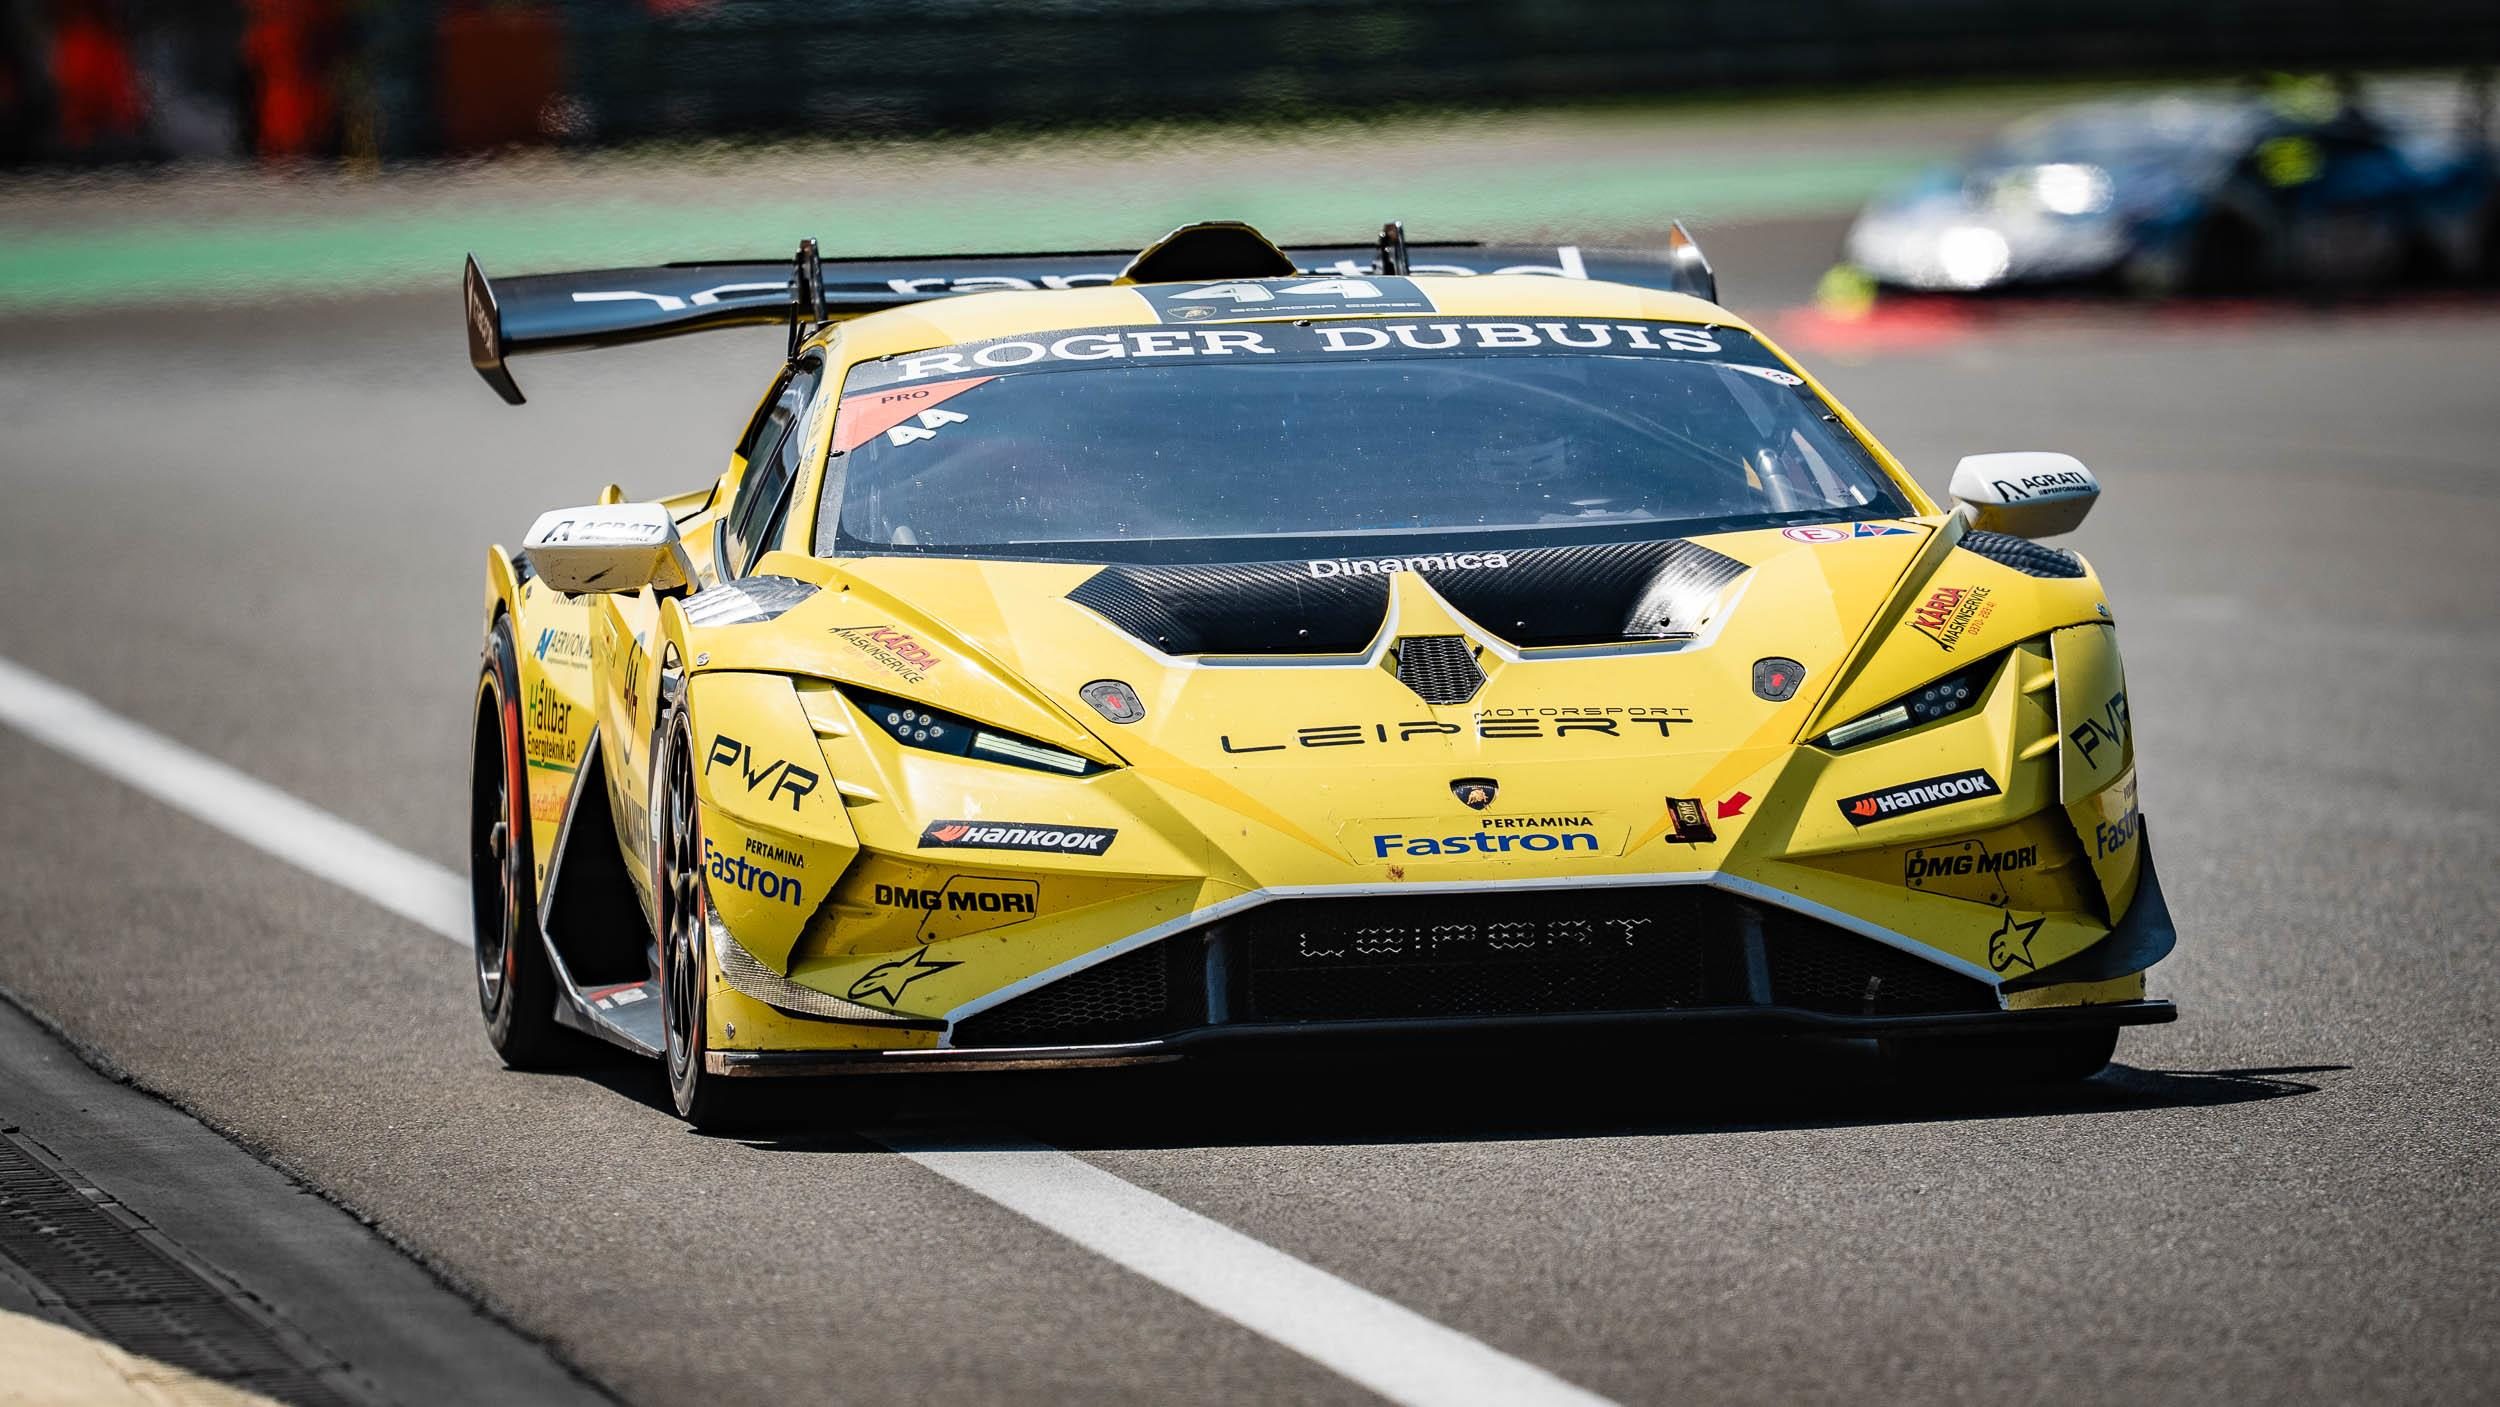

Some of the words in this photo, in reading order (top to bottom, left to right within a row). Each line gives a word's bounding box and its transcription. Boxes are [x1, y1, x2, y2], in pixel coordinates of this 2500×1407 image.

[1167, 279, 1383, 303] 44
[897, 330, 1276, 382] ROGER
[1314, 322, 1722, 354] DUBUIS
[881, 390, 930, 404] PRO
[2021, 471, 2088, 489] AGRATI
[1309, 552, 1509, 580] Dinamica
[1914, 587, 1967, 631] KÄRDA
[1941, 586, 1991, 645] MASKINSERVICE
[839, 630, 925, 685] MASKINSERVICE
[528, 678, 572, 735] Hållbar
[1474, 706, 1690, 720] MOTORSPORT
[1220, 717, 1694, 755] LEIPERT
[566, 740, 576, 763] AB
[705, 734, 819, 812] PWR
[1482, 816, 1594, 830] PERTAMINA
[745, 837, 805, 869] PERTAMINA
[1372, 830, 1600, 859] Fastron
[1907, 855, 1973, 879] DMG
[1976, 845, 2037, 874] MORI
[874, 884, 942, 911] DMG
[947, 891, 1035, 913] MORI
